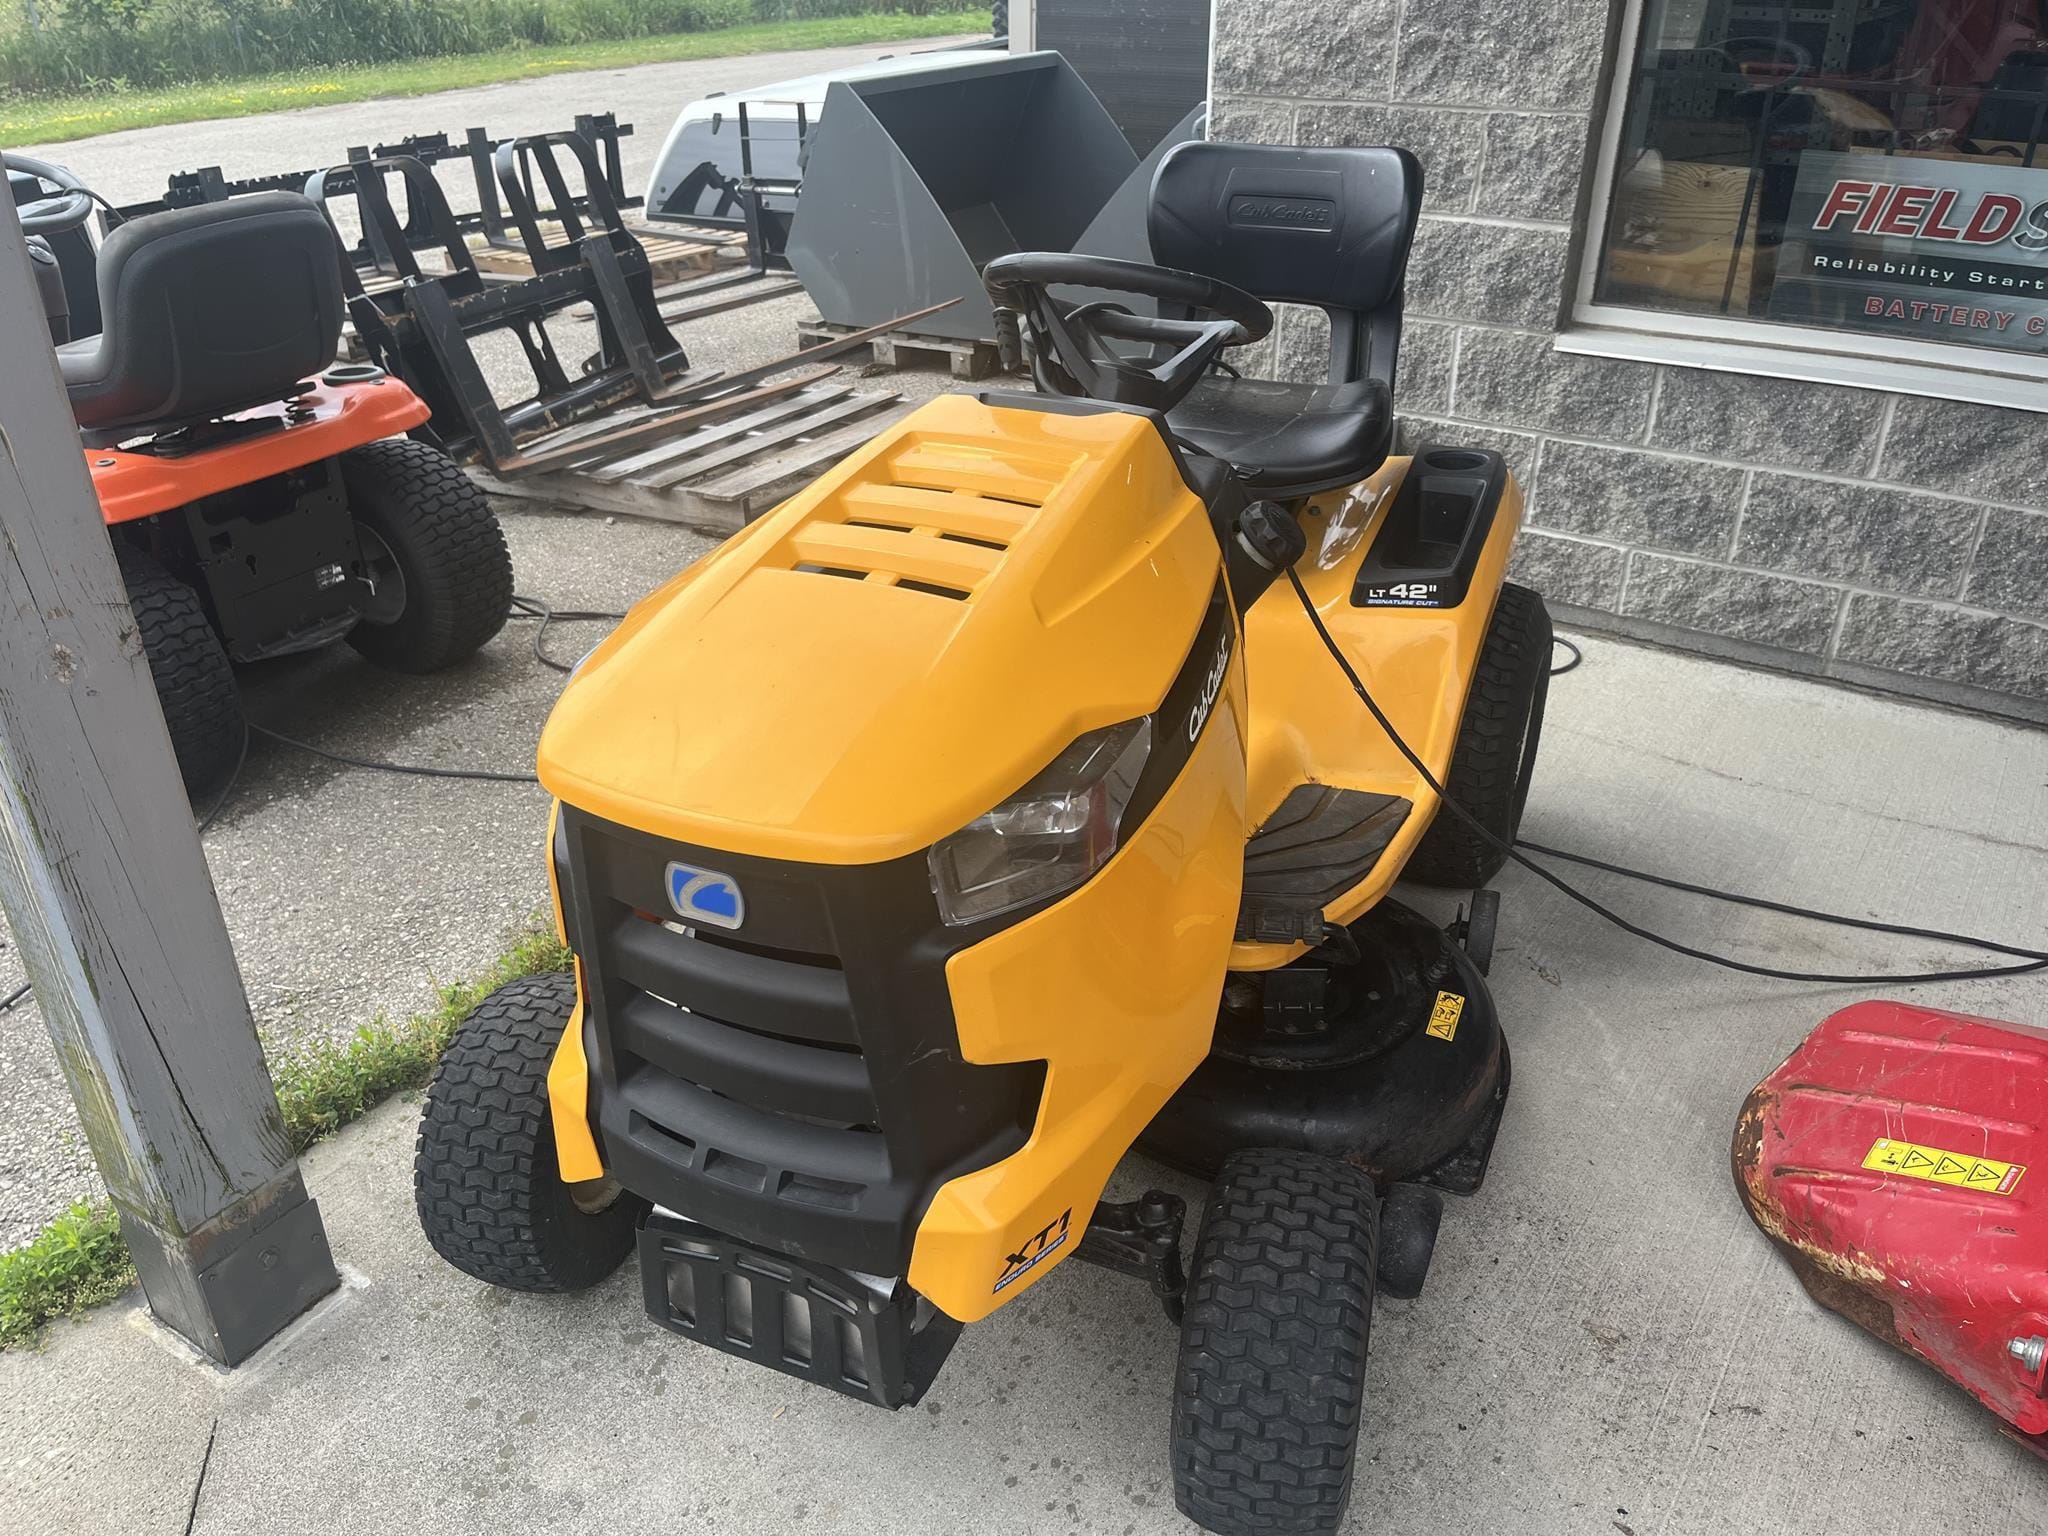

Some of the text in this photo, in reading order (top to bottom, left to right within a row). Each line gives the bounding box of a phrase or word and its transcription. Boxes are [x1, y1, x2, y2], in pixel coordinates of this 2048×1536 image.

[1813, 254, 1955, 283] Reliability
[1864, 296, 2015, 331] BATTERY
[1369, 583, 1437, 599] LT 42"
[1189, 633, 1229, 743] Cub Cadet
[998, 1206, 1073, 1281] XT1
[994, 1260, 1034, 1292] ENDURO
